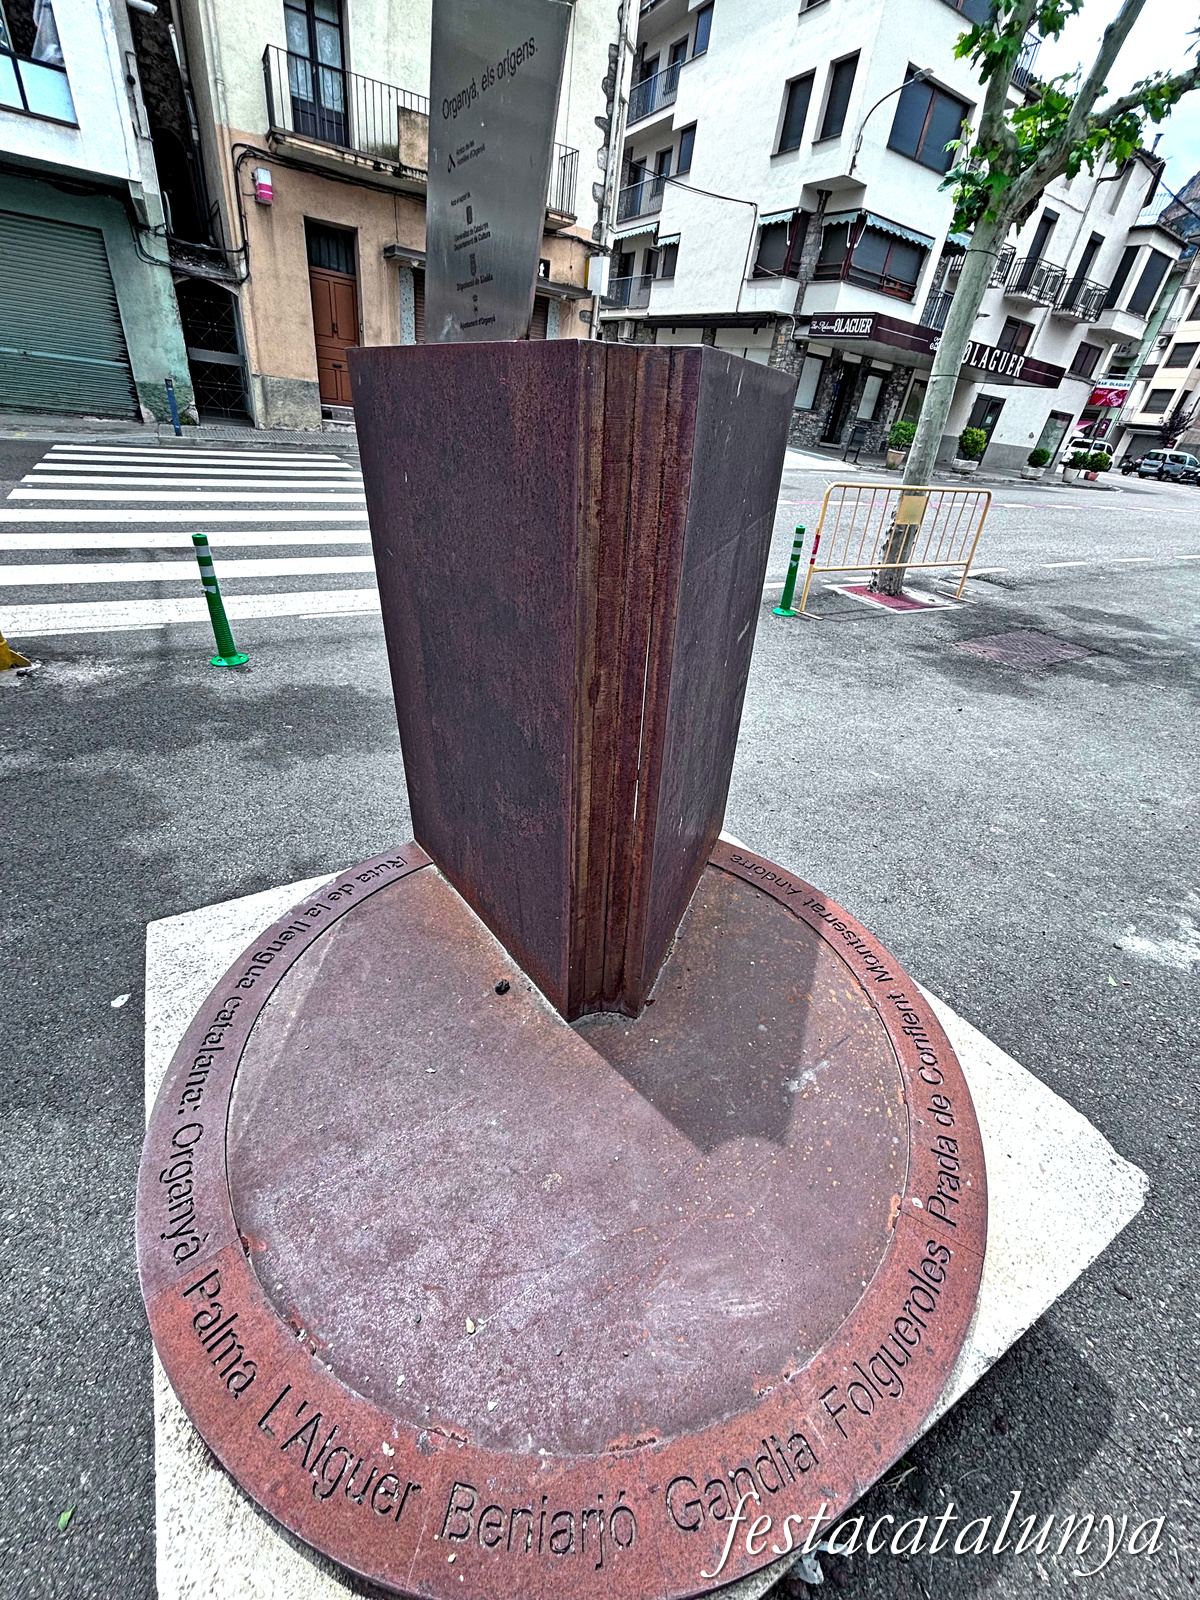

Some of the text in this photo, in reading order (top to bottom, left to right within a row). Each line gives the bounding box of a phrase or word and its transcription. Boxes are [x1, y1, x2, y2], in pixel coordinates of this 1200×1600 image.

[441, 78, 480, 120] Organyà,
[481, 65, 495, 91] els
[834, 318, 873, 333] OLAGUER
[962, 341, 1025, 378] OLAGUER
[158, 853, 960, 1571] Ruta de la llengua catalana: Organyà Palma L'Alguer Beniarjó Gandia Folgueroles Prada de Conflent Montserrat Andorra
